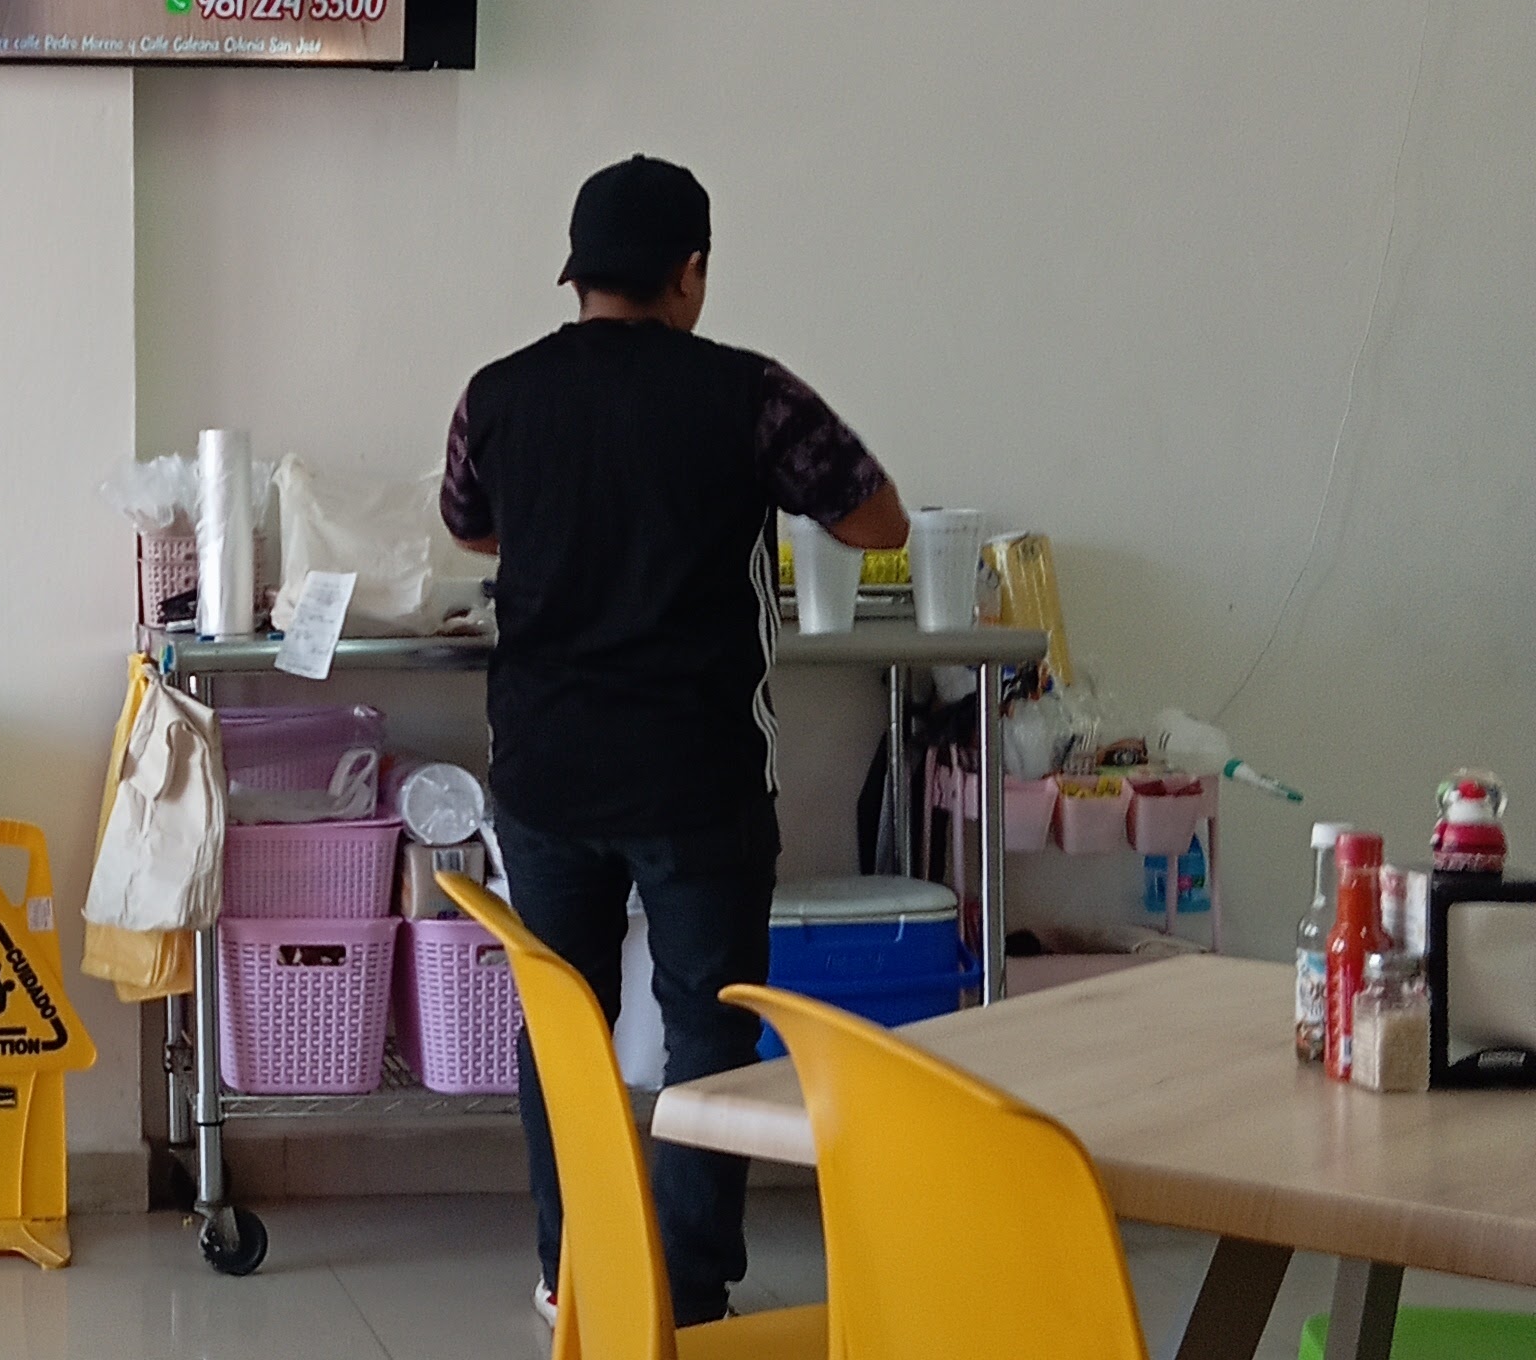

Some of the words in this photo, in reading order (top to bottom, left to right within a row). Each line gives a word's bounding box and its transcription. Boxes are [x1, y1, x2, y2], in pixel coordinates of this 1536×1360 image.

[128, 39, 136, 56] y
[269, 36, 292, 53] San
[6, 948, 57, 1019] CUIDADO
